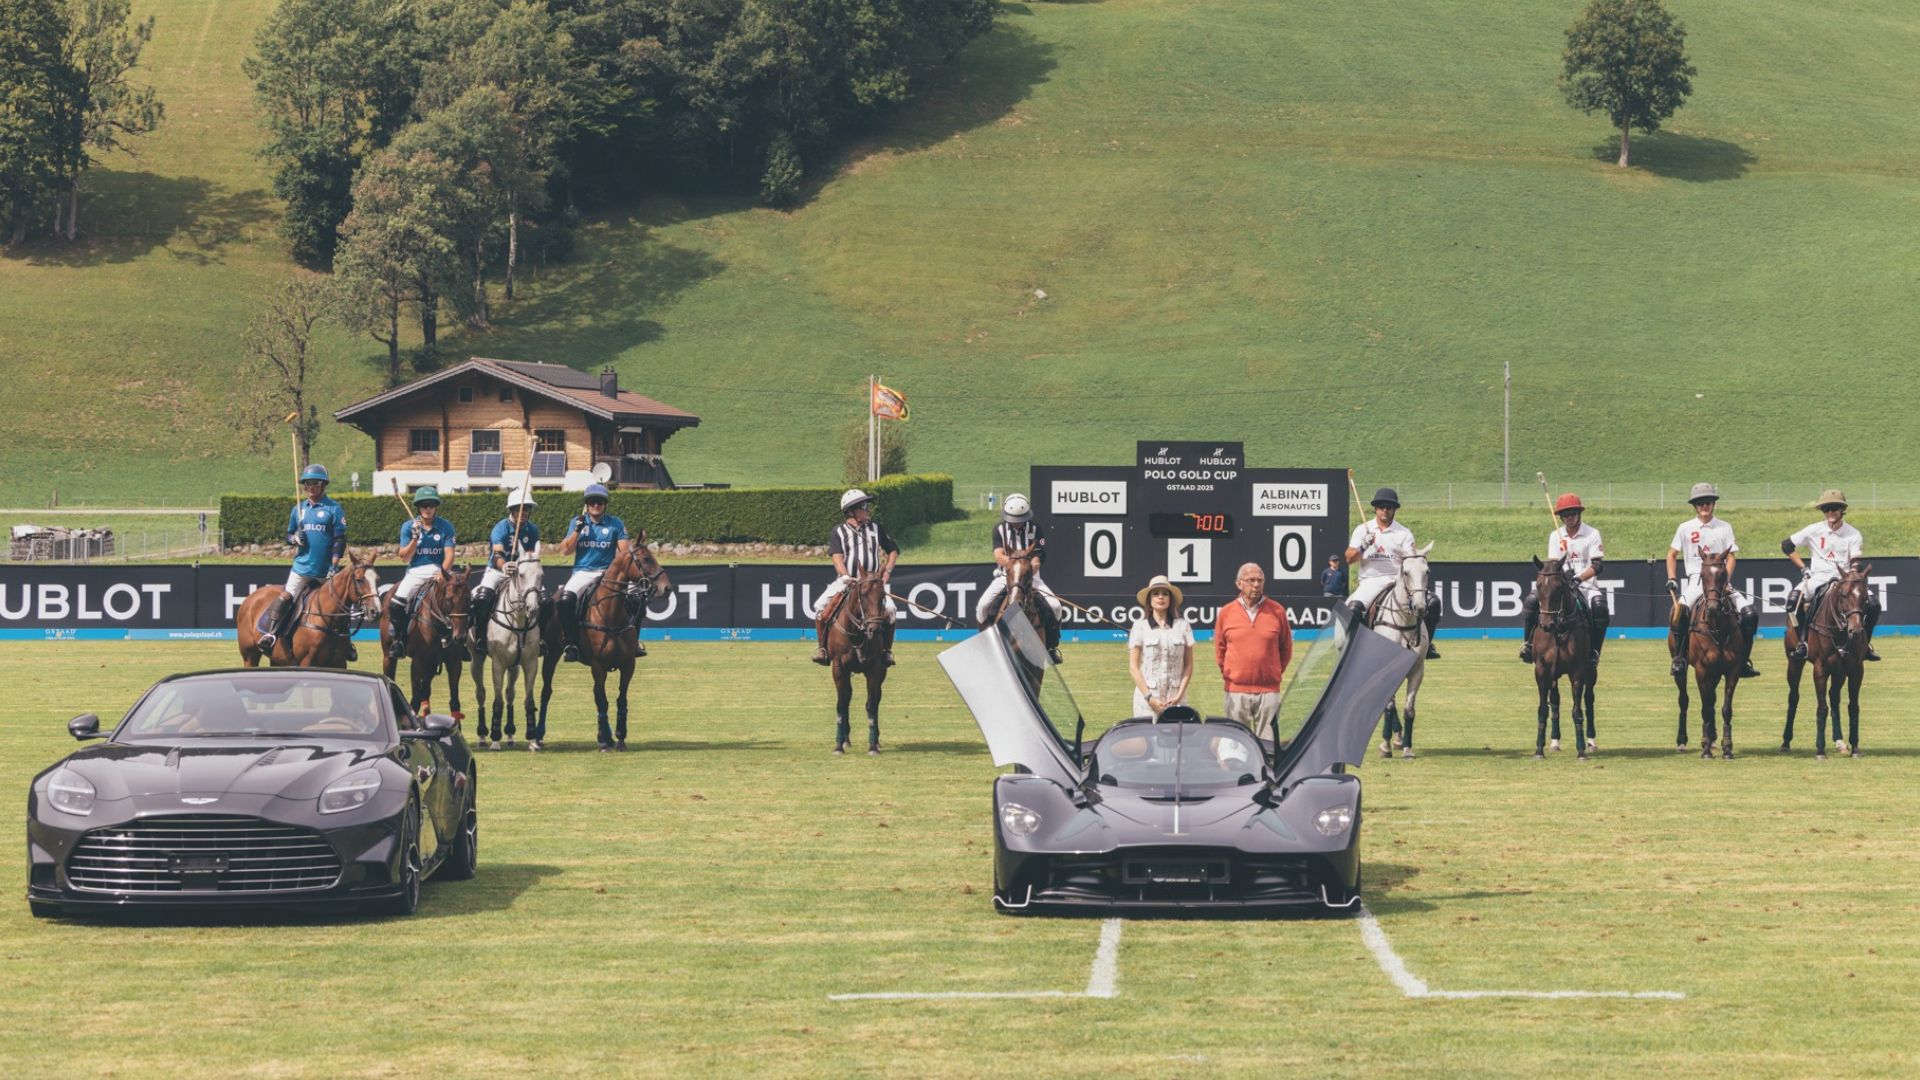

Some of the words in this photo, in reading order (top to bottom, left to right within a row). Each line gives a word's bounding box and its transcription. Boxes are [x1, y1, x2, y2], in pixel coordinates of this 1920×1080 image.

[1144, 457, 1181, 465] HUBLOT
[1200, 457, 1237, 466] HUBLOT
[1144, 470, 1176, 479] POLO
[1179, 470, 1211, 479] GOLD
[1214, 471, 1237, 480] CUP
[1057, 491, 1120, 503] HUBLOT
[1260, 490, 1321, 499] ALBINATI
[303, 523, 326, 531] UBLOT
[1691, 531, 1700, 543] 2
[1820, 536, 1825, 549] 1
[417, 547, 442, 555] UBLOT
[1090, 529, 1117, 569] 0
[1279, 532, 1307, 572] 0
[1179, 543, 1198, 577] 1
[0, 583, 171, 620] UBLOT
[762, 582, 977, 620] HUOT
[1060, 606, 1104, 624] OLO
[1183, 606, 1221, 624] CU
[1286, 607, 1332, 625] AAD
